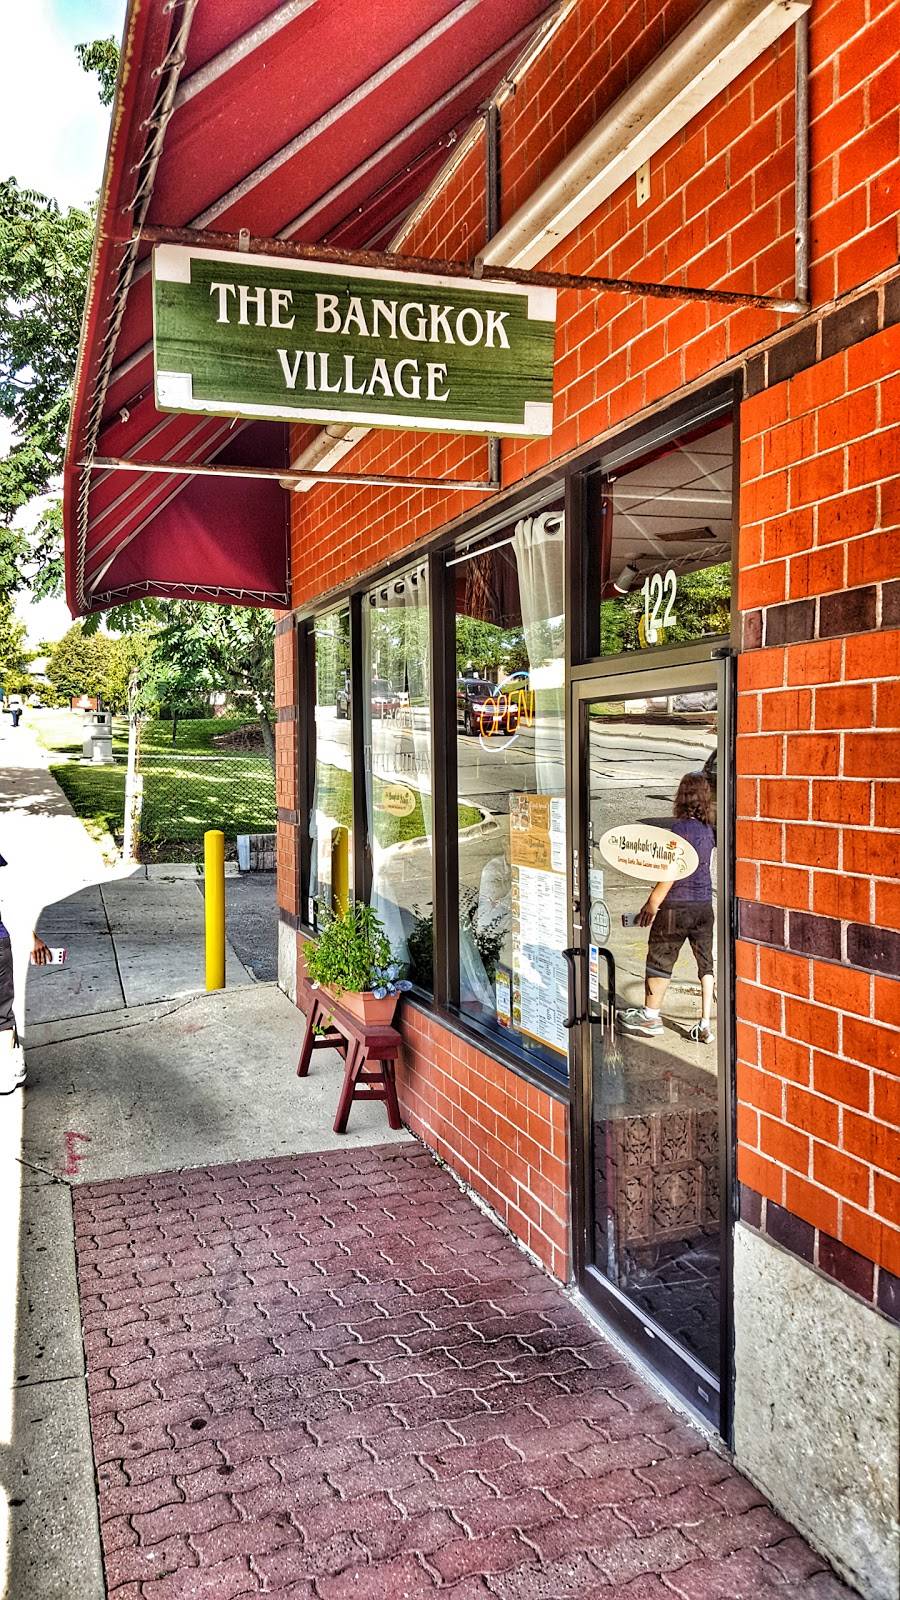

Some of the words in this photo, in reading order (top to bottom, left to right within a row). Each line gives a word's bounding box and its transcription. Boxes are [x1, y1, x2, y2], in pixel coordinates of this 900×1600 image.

[210, 282, 296, 330] THE
[315, 293, 510, 349] BANGKOK
[277, 349, 450, 401] VILLAGE
[641, 569, 677, 631] 122
[480, 689, 535, 737] OPEN
[619, 836, 649, 853] Bangkok
[650, 842, 676, 864] Village
